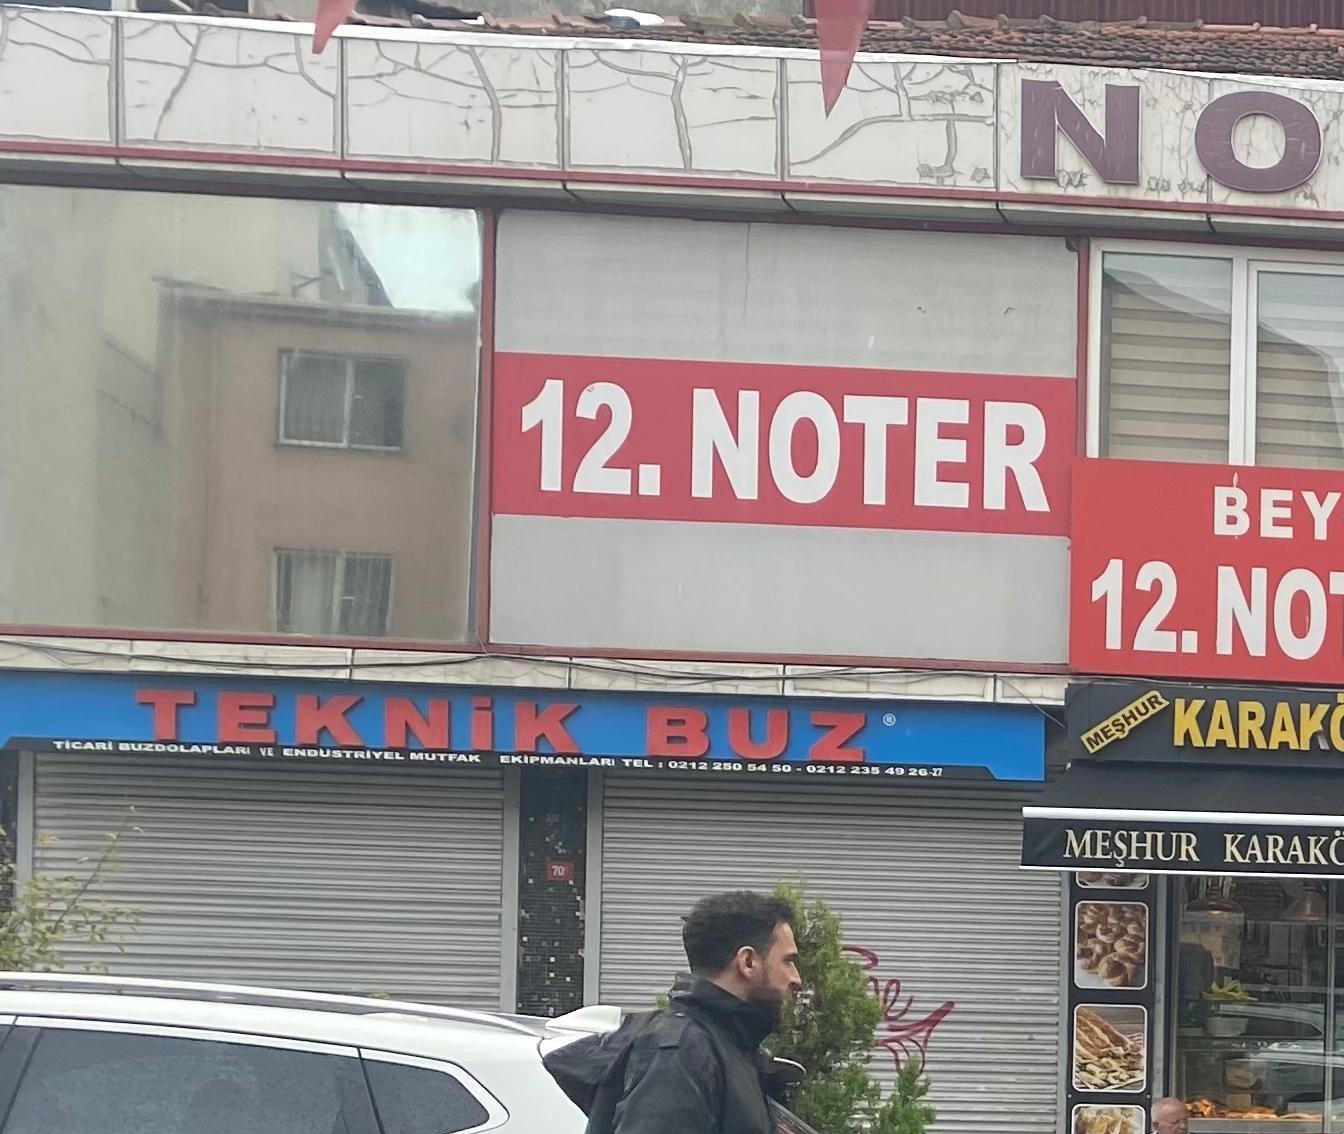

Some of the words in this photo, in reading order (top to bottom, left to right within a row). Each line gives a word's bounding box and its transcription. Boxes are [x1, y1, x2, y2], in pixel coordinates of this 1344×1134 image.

[520, 378, 661, 496] 12.
[691, 387, 1051, 513] NOTER
[1090, 558, 1198, 654] 12.
[646, 704, 868, 763] BUZ
[1085, 694, 1164, 750] MEŞHUR
[118, 742, 250, 755] BUZDOLAPLARI
[259, 746, 275, 757] VE
[409, 751, 481, 763] MUTFAK
[621, 758, 654, 768] TEL
[668, 759, 708, 771] 0212
[711, 761, 742, 771] 250
[747, 762, 767, 772] 54
[771, 763, 792, 773] 50
[806, 764, 846, 774] 0212
[850, 765, 880, 775] 235
[884, 766, 905, 776] 49
[1063, 828, 1200, 869] MEŞHUR
